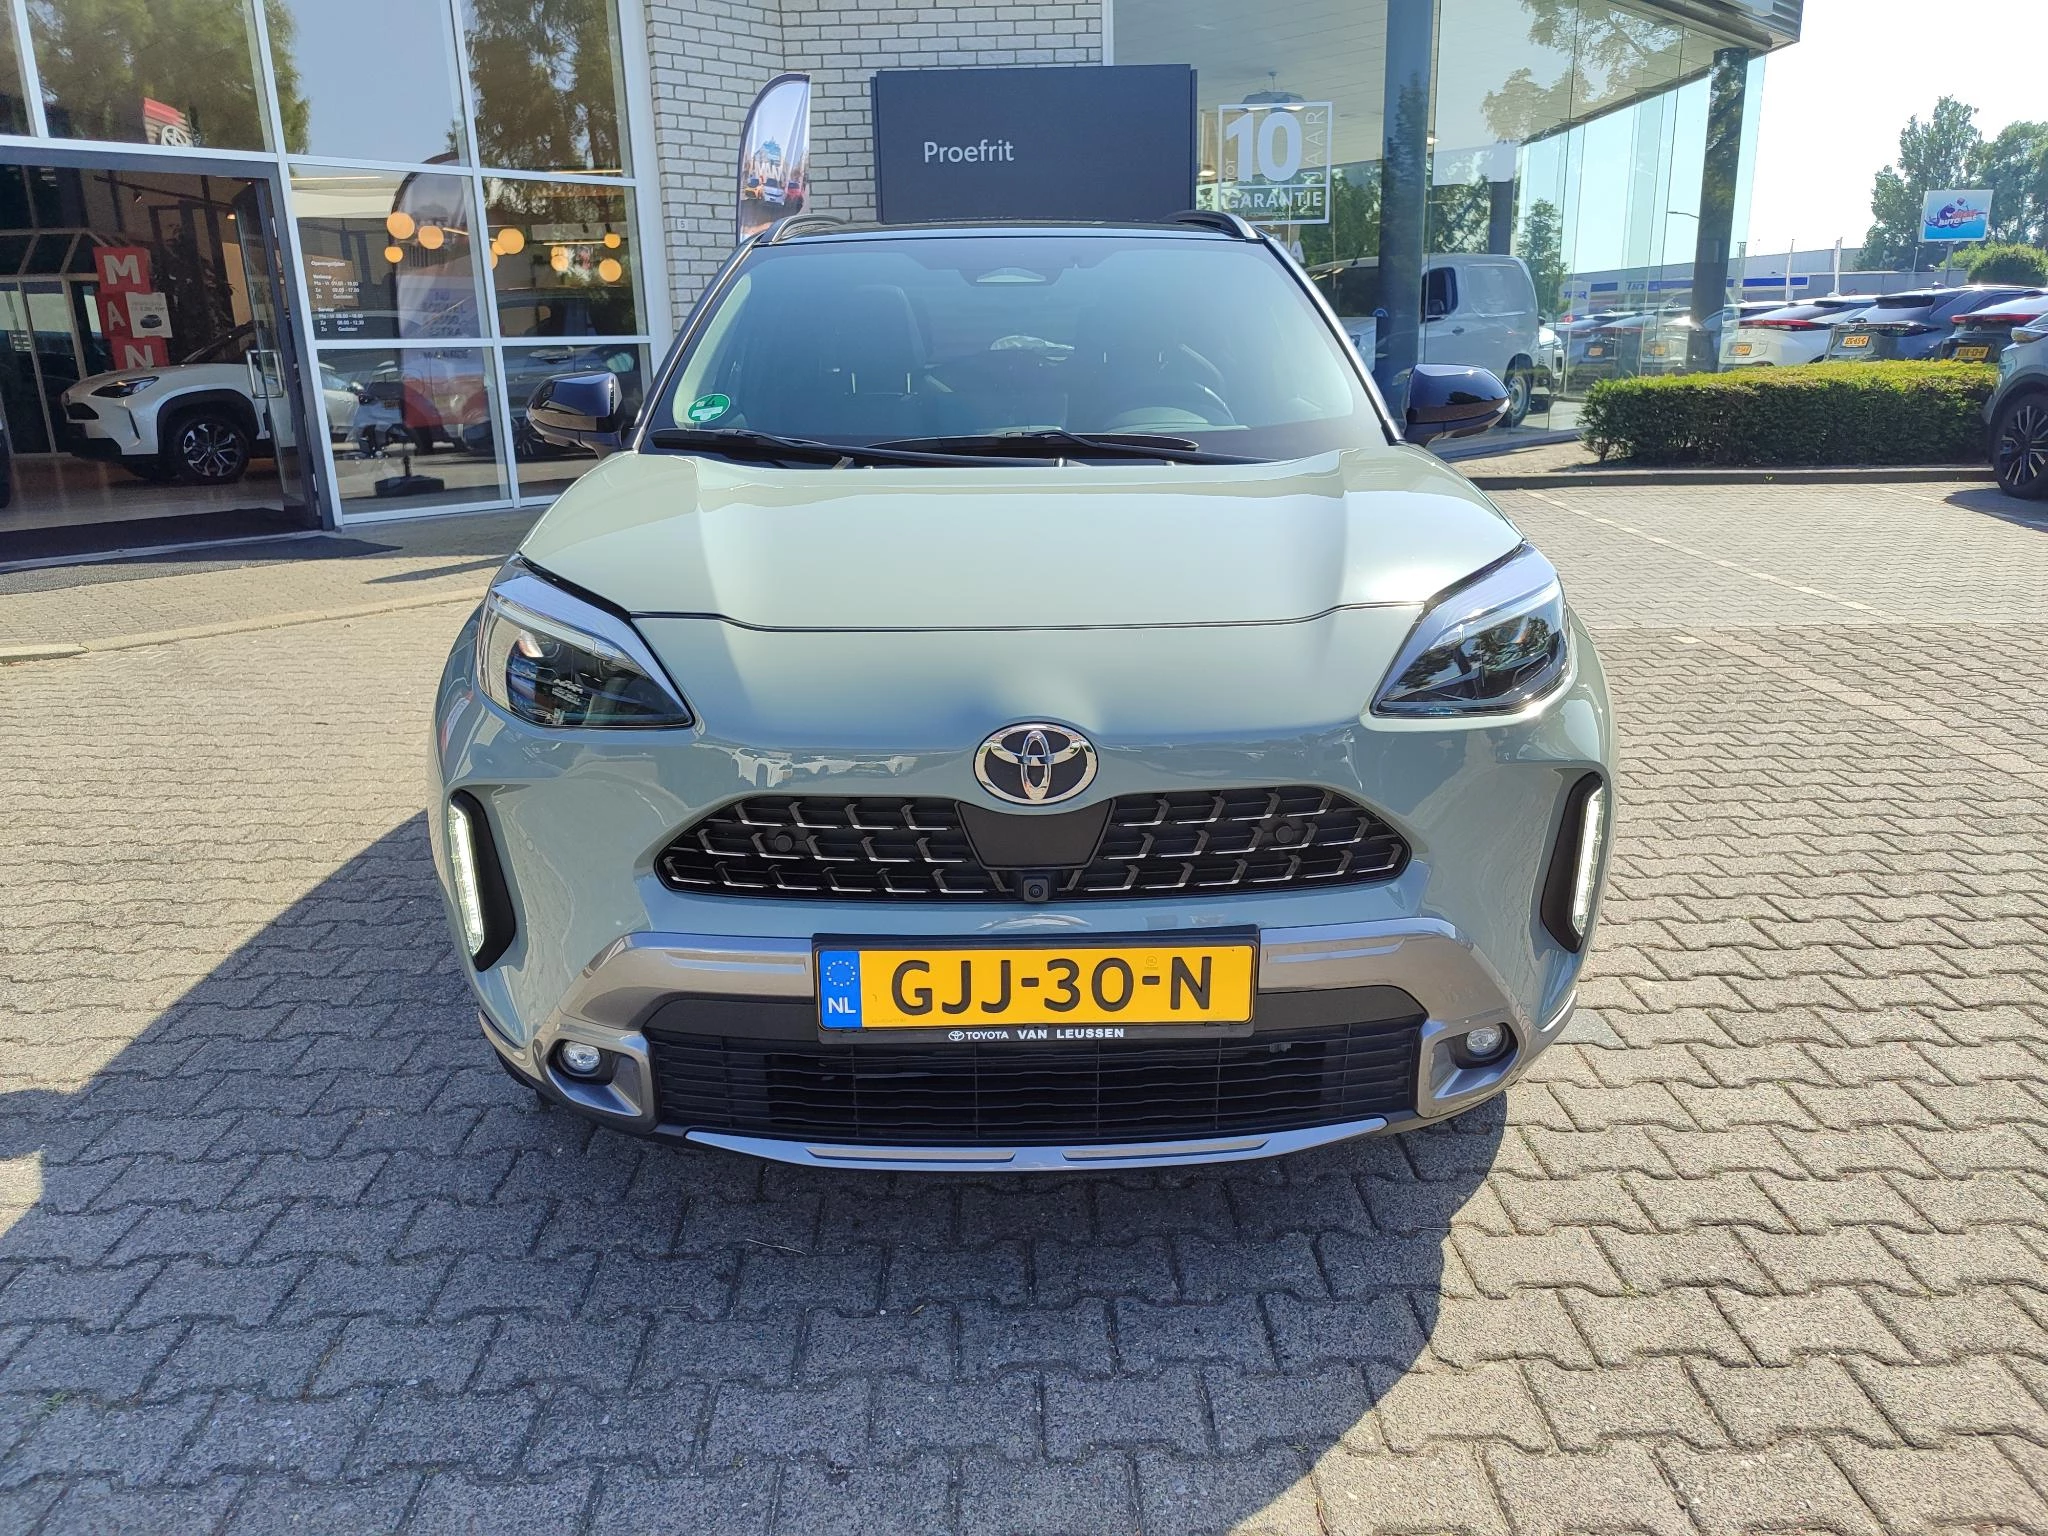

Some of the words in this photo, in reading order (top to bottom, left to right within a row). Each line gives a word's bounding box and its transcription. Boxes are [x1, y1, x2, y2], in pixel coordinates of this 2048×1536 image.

[923, 139, 1015, 163] Proefrit
[1226, 111, 1302, 182] 10
[1301, 110, 1325, 180] JAAR
[1225, 158, 1237, 182] TOT
[1225, 191, 1322, 209] GARANTIE
[891, 956, 1213, 1016] GJJ-30-N
[828, 997, 857, 1014] NL
[966, 1031, 1009, 1040] TOYOTA
[1017, 1029, 1048, 1039] VAN
[1056, 1028, 1125, 1039] LEUSSEN
